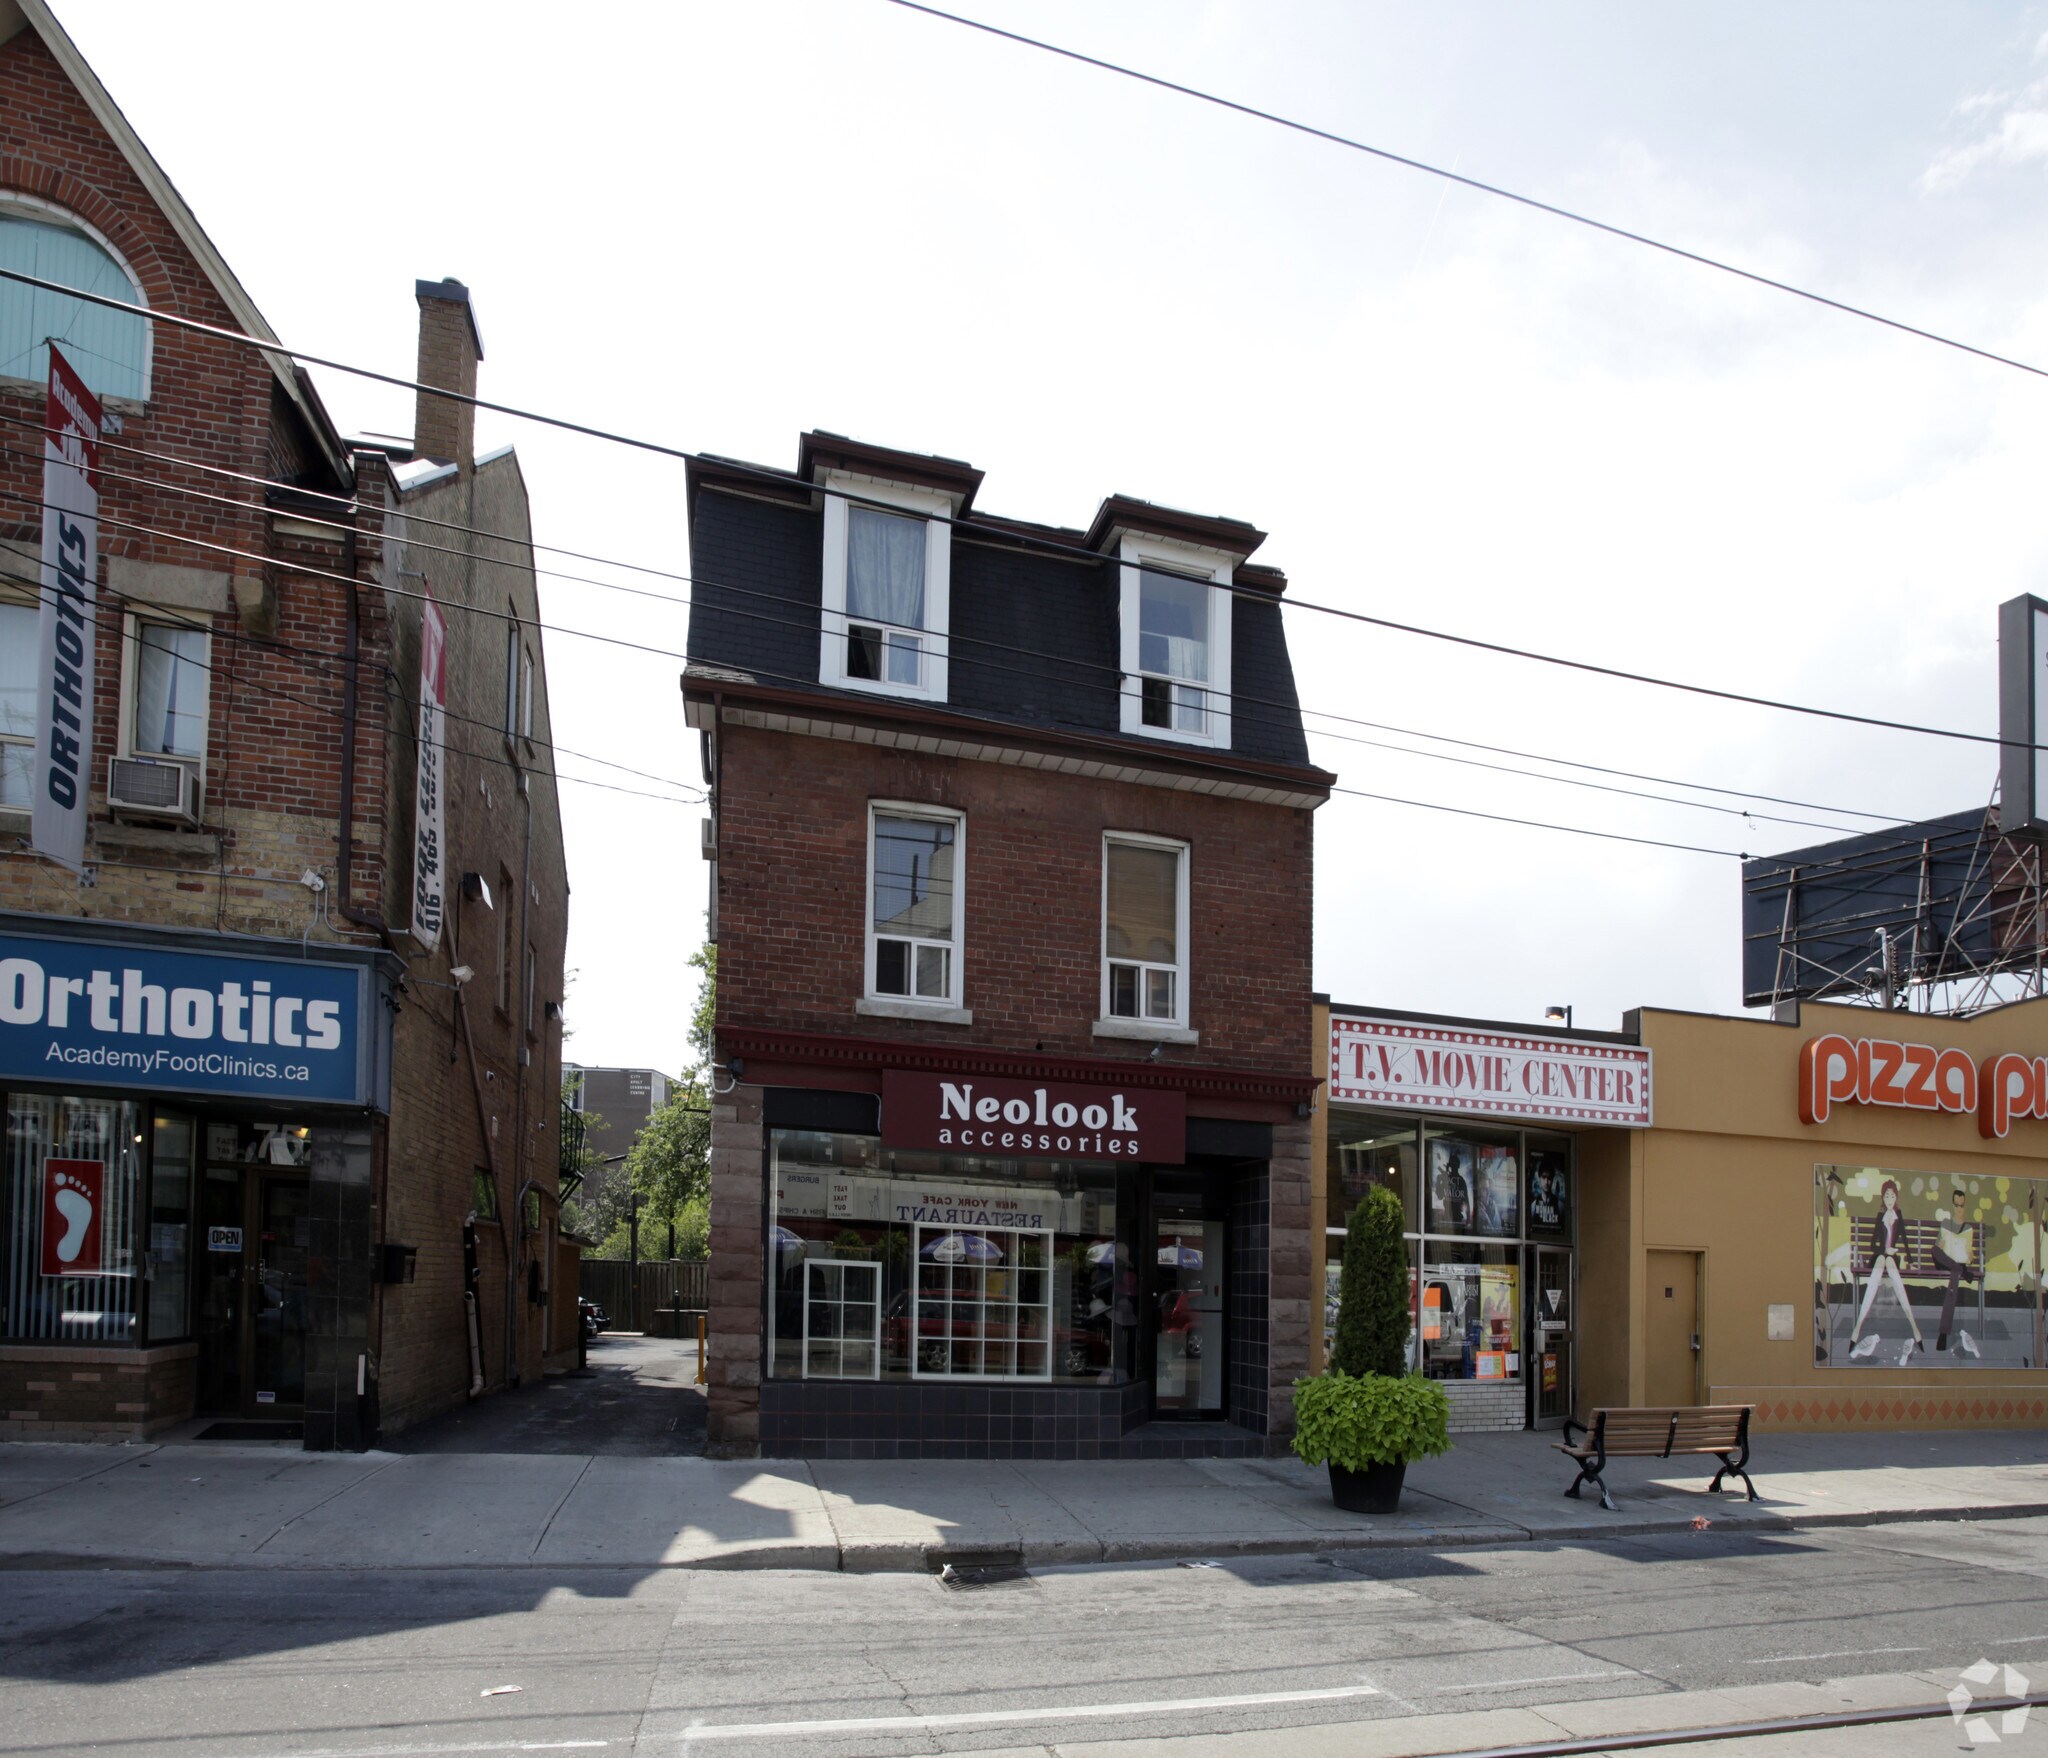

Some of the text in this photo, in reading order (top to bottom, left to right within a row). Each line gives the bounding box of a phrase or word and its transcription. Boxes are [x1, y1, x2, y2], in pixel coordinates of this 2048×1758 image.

[52, 367, 98, 451] Academy
[48, 511, 87, 811] ORTHOTICS
[415, 822, 429, 930] FOOT
[0, 958, 341, 1050] Orthotics
[45, 1040, 310, 1082] AcademyFootClinics.ca
[1348, 1041, 1636, 1105] T.V. MOVIE CENTER
[939, 1082, 1139, 1133] Neolook
[939, 1127, 1139, 1155] accessories
[212, 1230, 240, 1245] OPEN
